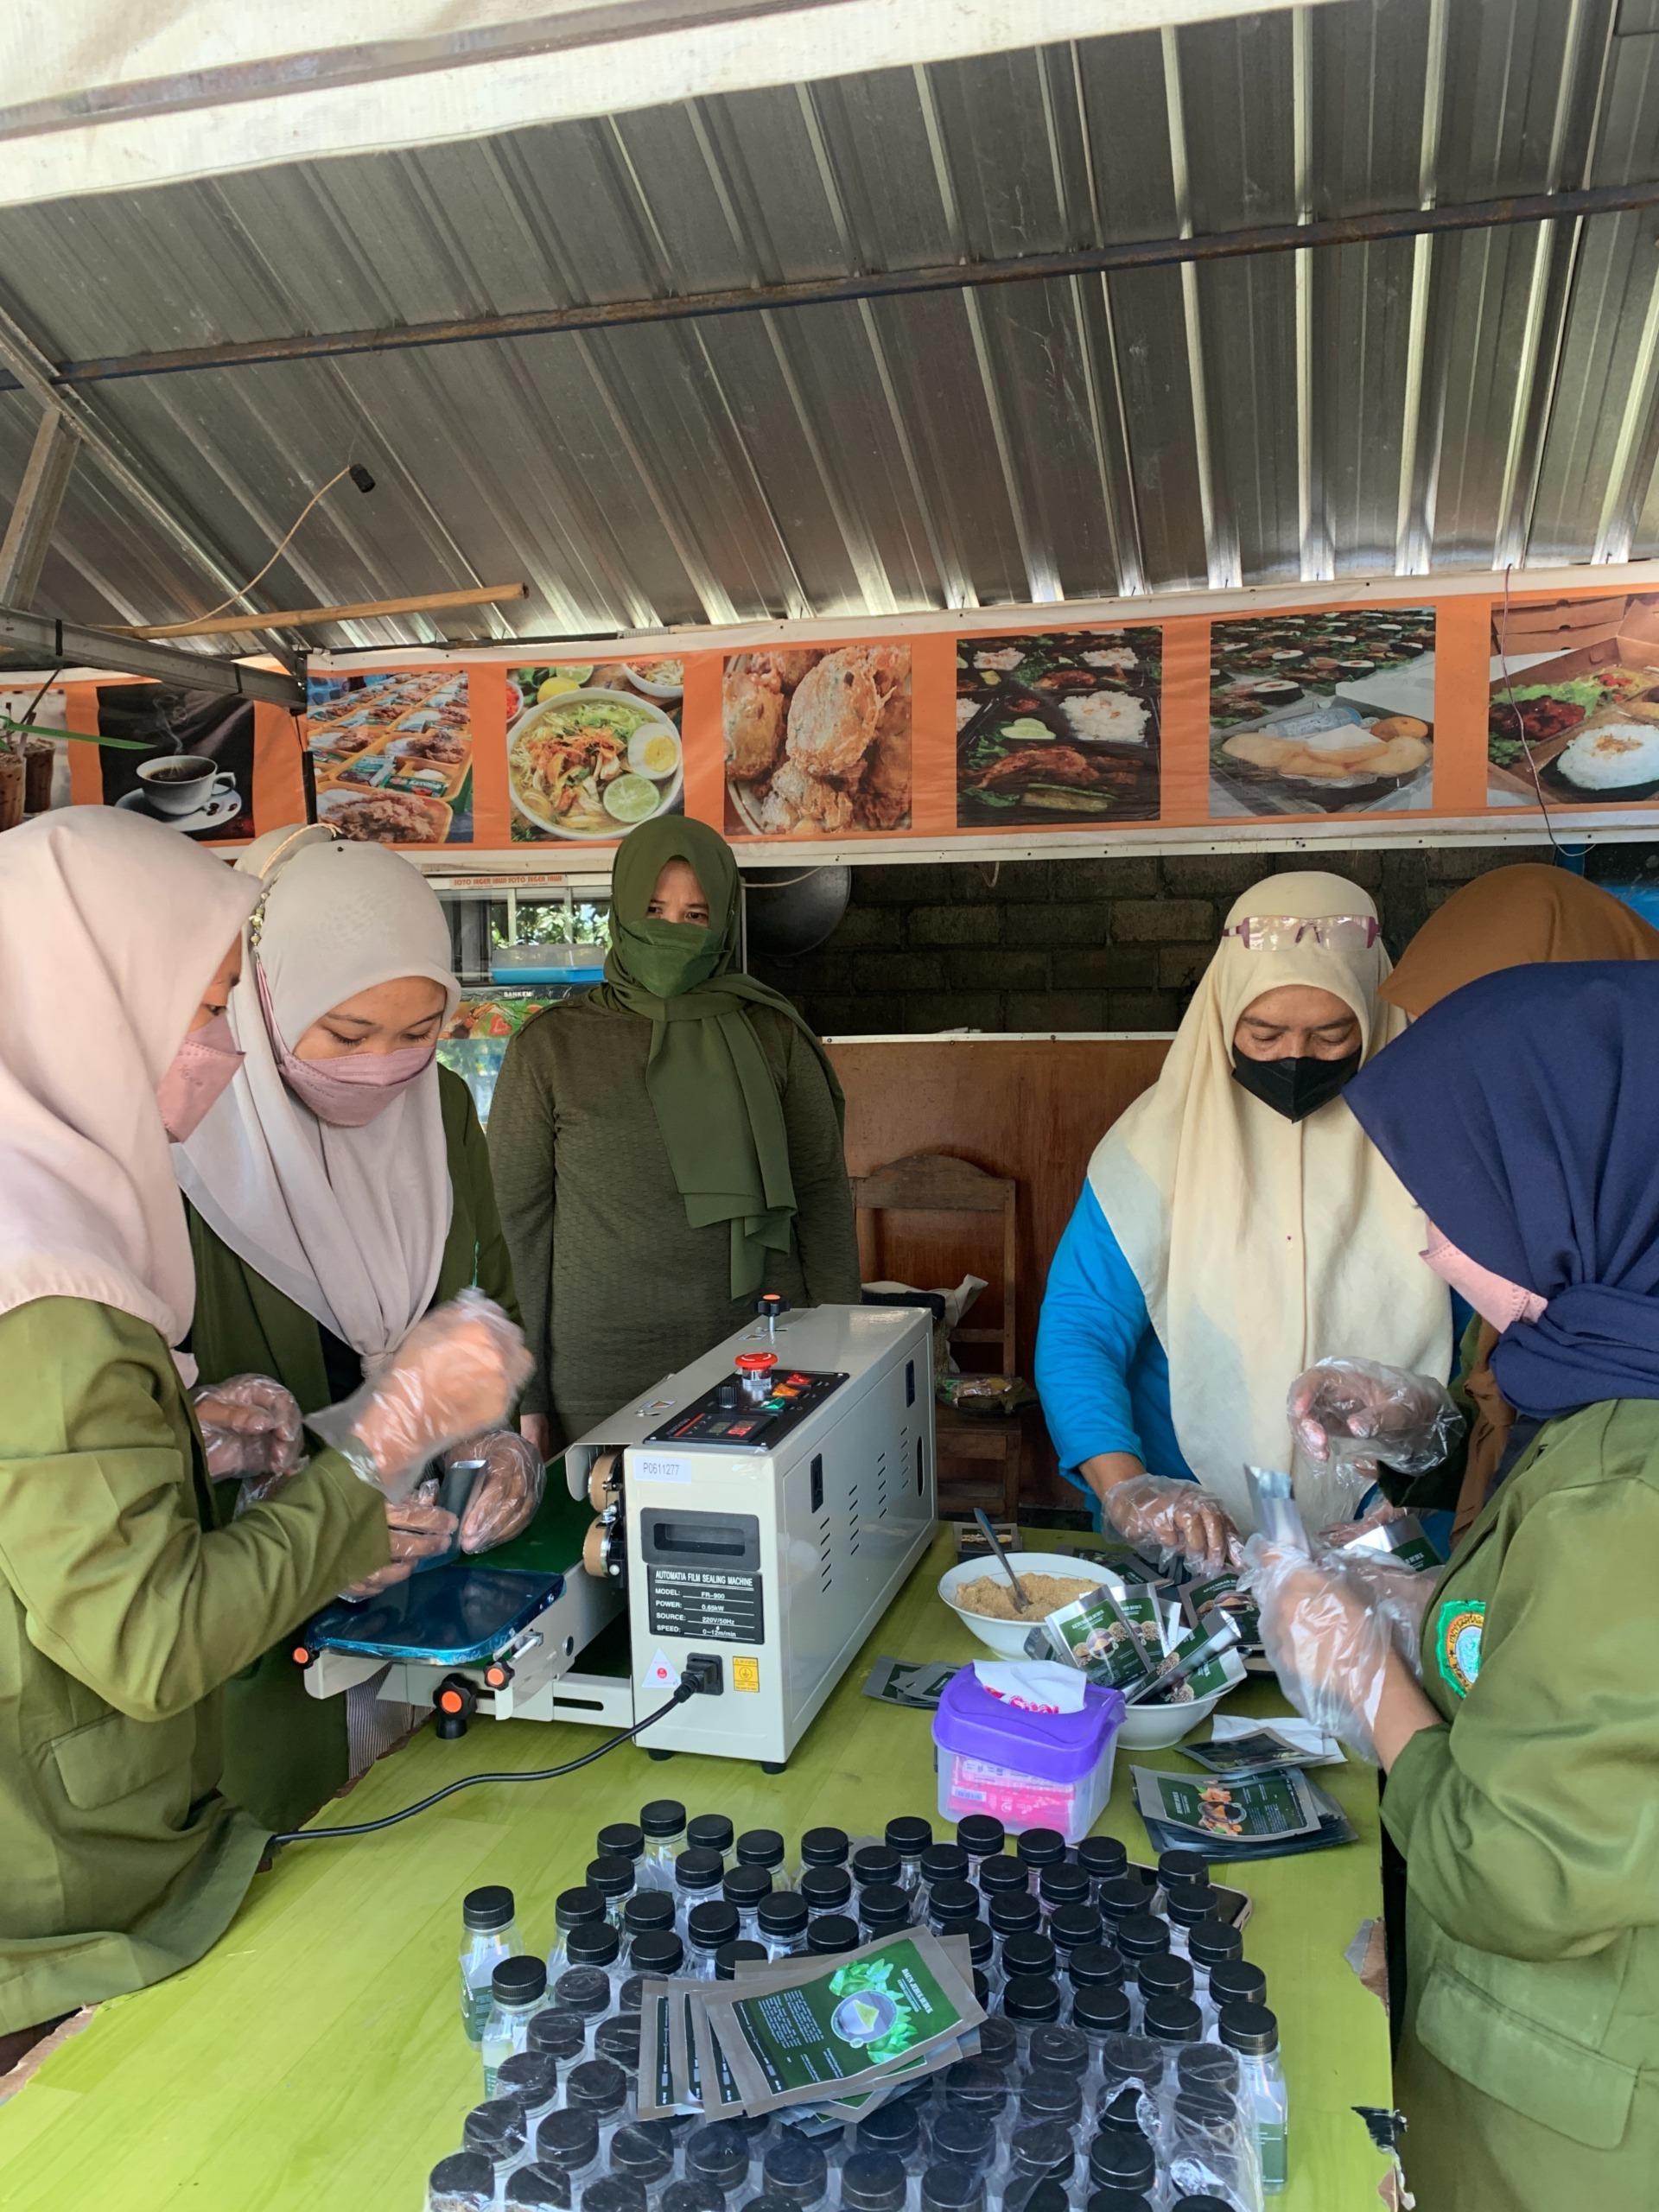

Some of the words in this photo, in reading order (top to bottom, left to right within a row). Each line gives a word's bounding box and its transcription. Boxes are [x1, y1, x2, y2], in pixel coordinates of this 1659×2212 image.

[643, 1462, 679, 1476] P0611277
[655, 1570, 686, 1581] AUTOMATIA
[688, 1573, 701, 1582] FILM
[702, 1573, 726, 1584] SEALING
[727, 1575, 753, 1586] MACHINE
[655, 1587, 680, 1596] MODEL:
[655, 1599, 682, 1608] POWER:
[656, 1611, 686, 1621] SOURCE:
[702, 1616, 735, 1625] 220V/50Hz
[656, 1624, 681, 1633] SPEED:
